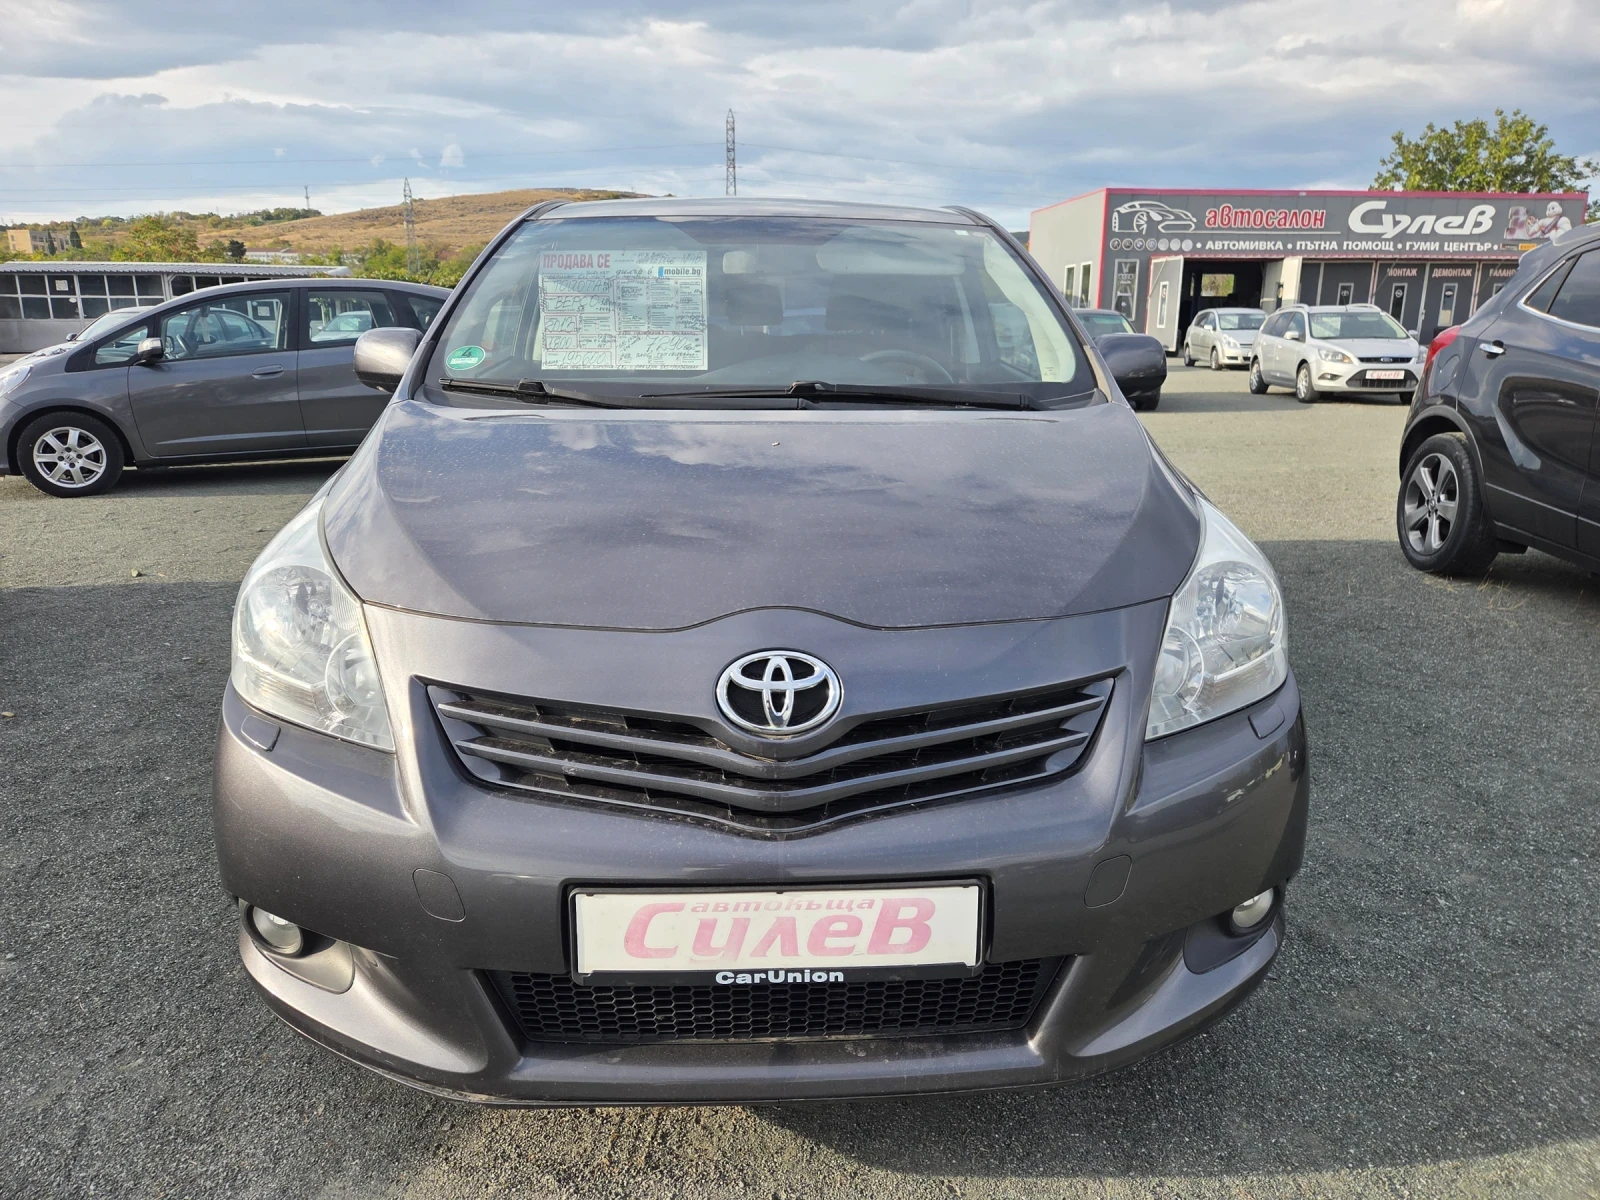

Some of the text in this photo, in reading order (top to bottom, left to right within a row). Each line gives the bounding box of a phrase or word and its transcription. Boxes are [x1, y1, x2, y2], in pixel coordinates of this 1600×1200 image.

[1205, 203, 1326, 229] автосалон
[1205, 240, 1284, 251] АВТОМИВКА
[1296, 240, 1339, 251] ПЪТНА
[1343, 240, 1394, 252] ПОМОЩ
[1406, 241, 1440, 251] ГУМИ
[1444, 241, 1492, 252] ЦЕНТЪР
[543, 253, 611, 269] ПРОДАВА СЕ
[663, 267, 702, 277] mobile.bg
[1432, 267, 1472, 278] ДЕМОНТАЖ
[690, 898, 875, 913] автокъща
[715, 970, 844, 985] CarUnion
